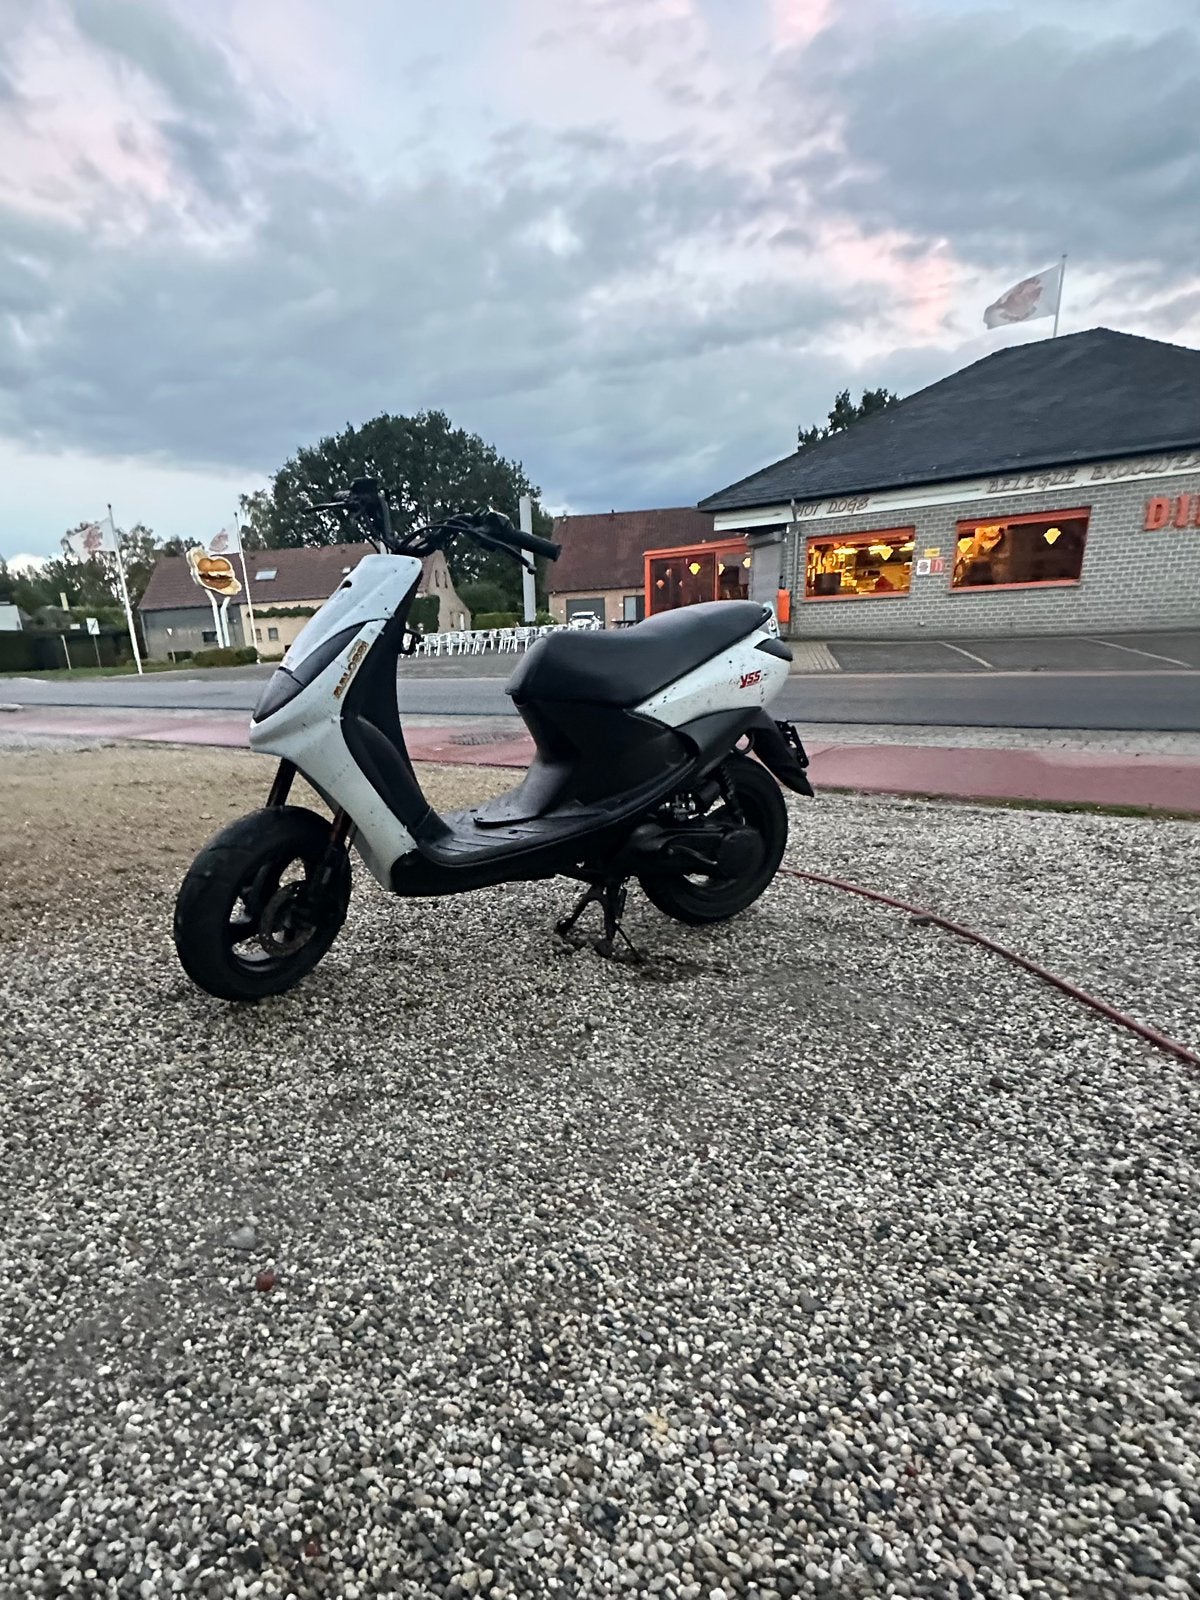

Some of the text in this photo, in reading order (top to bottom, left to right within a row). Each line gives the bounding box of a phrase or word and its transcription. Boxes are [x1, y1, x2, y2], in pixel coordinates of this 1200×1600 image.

[986, 468, 1078, 492] BELEGDE
[826, 497, 871, 514] DOGS
[1143, 492, 1200, 531] DI
